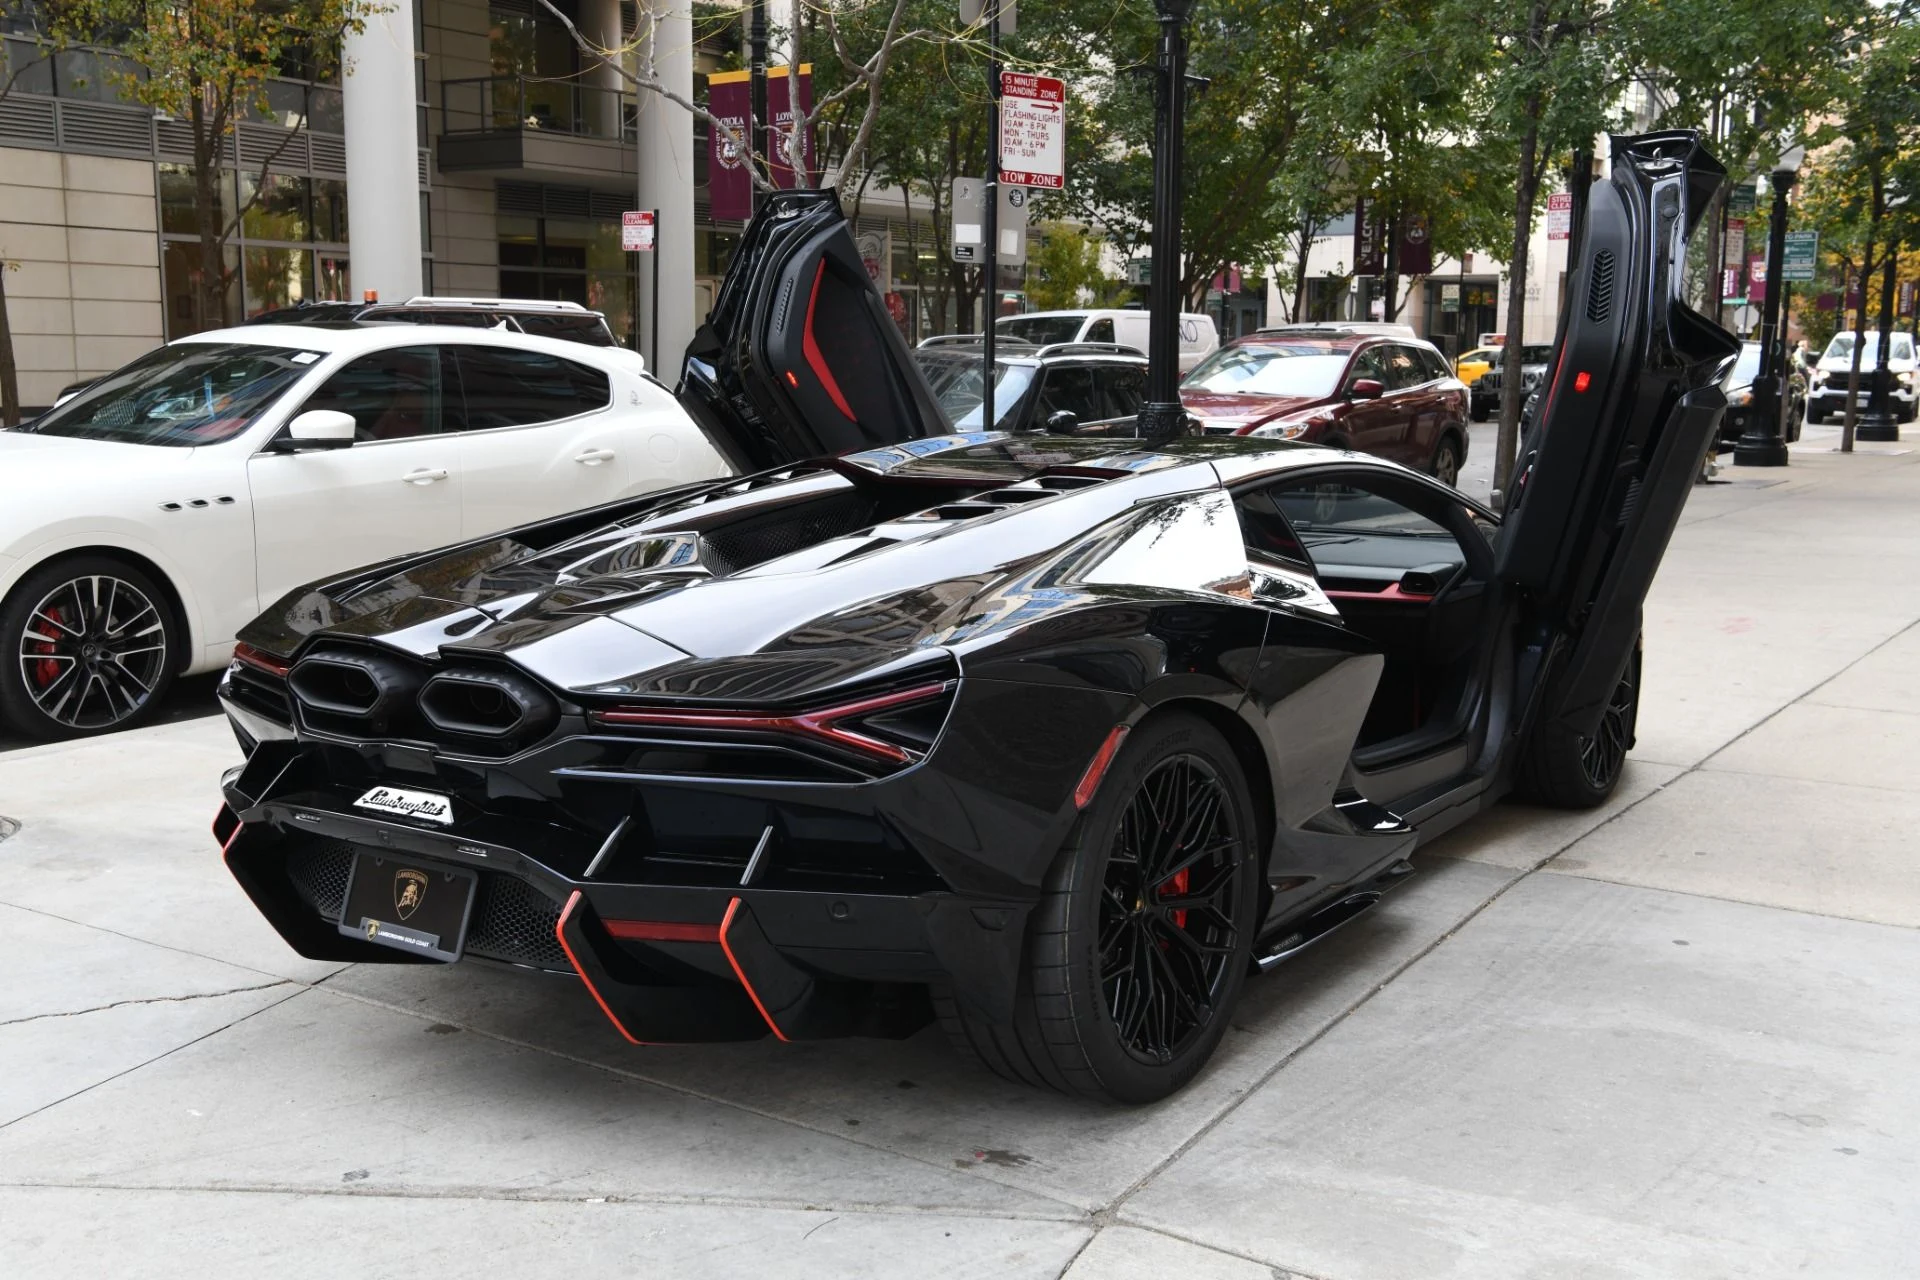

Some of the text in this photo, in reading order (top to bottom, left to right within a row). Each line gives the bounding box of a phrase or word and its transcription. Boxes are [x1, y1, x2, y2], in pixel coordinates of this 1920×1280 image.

[1005, 75, 1039, 88] 15 MINUTE
[1005, 85, 1058, 100] STANDING ZONE
[1004, 100, 1019, 109] USE
[1004, 110, 1061, 124] FLASHING LIGHTS
[1004, 129, 1020, 138] MON
[1027, 130, 1050, 141] THURS
[1029, 141, 1035, 149] 6
[1035, 141, 1046, 149] PM
[1004, 147, 1016, 155] FRI
[1021, 149, 1037, 158] SUN
[1003, 171, 1058, 187] TOW ZONE
[361, 789, 447, 816] Lamborghini
[415, 939, 430, 947] COAST
